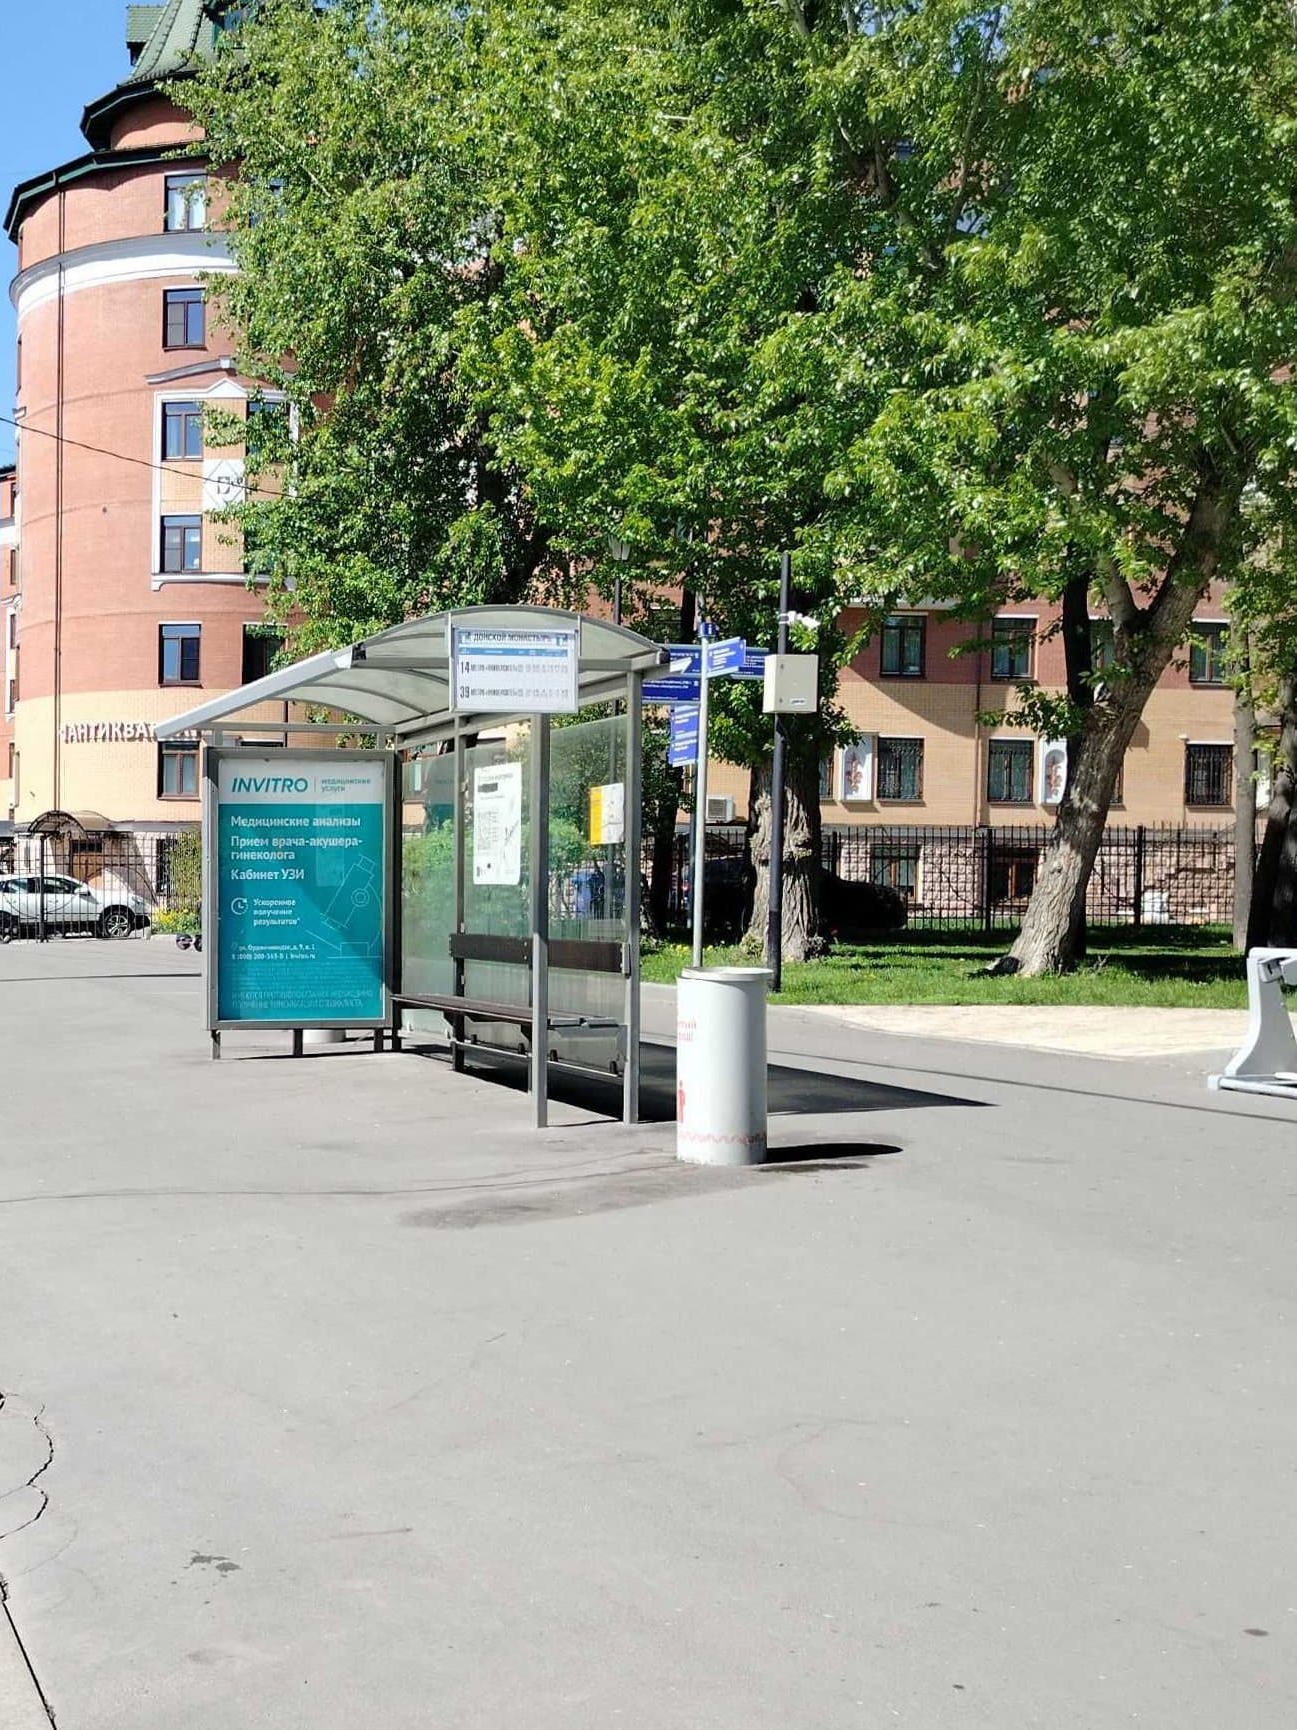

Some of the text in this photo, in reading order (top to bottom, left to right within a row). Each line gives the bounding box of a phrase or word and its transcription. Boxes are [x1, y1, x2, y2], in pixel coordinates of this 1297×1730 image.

[460, 661, 470, 674] 14
[460, 686, 470, 699] 39
[231, 777, 308, 793] INVITRO
[231, 815, 361, 828] Медицинские анализы
[230, 835, 363, 849] Прием врача-акушера-
[230, 850, 296, 861] гинеколога
[230, 868, 305, 880] Кабинет УЗИ
